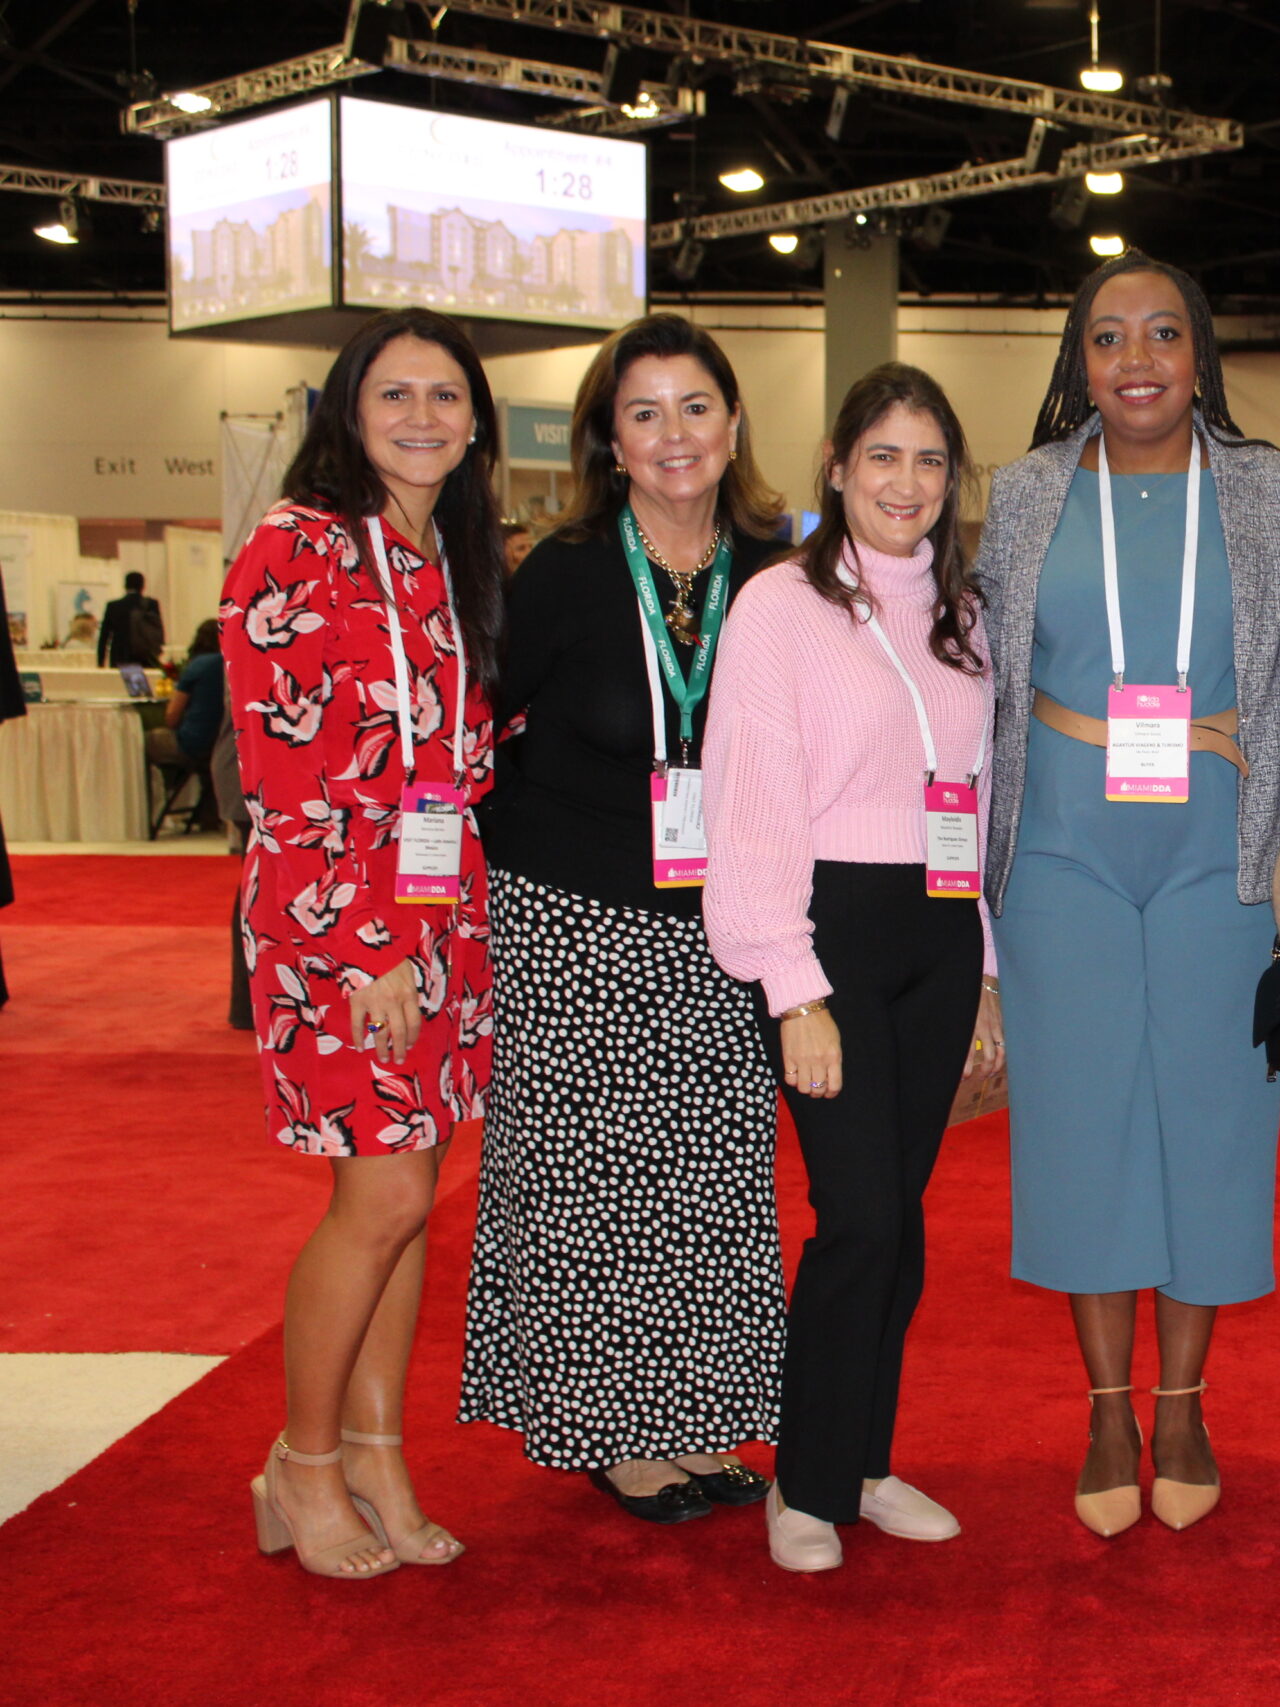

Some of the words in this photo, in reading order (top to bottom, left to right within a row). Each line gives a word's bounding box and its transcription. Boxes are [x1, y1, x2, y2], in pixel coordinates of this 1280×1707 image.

[265, 149, 299, 181] 1:28
[535, 167, 593, 201] 1:28
[534, 422, 570, 446] VISIT
[94, 456, 137, 477] Exit
[166, 456, 215, 477] West
[622, 516, 639, 554] FLORIDA
[637, 575, 658, 617] FLORIDA
[708, 573, 725, 612] FLORIDA
[657, 639, 677, 679] FLORIDA
[696, 633, 713, 672] FLORIDA
